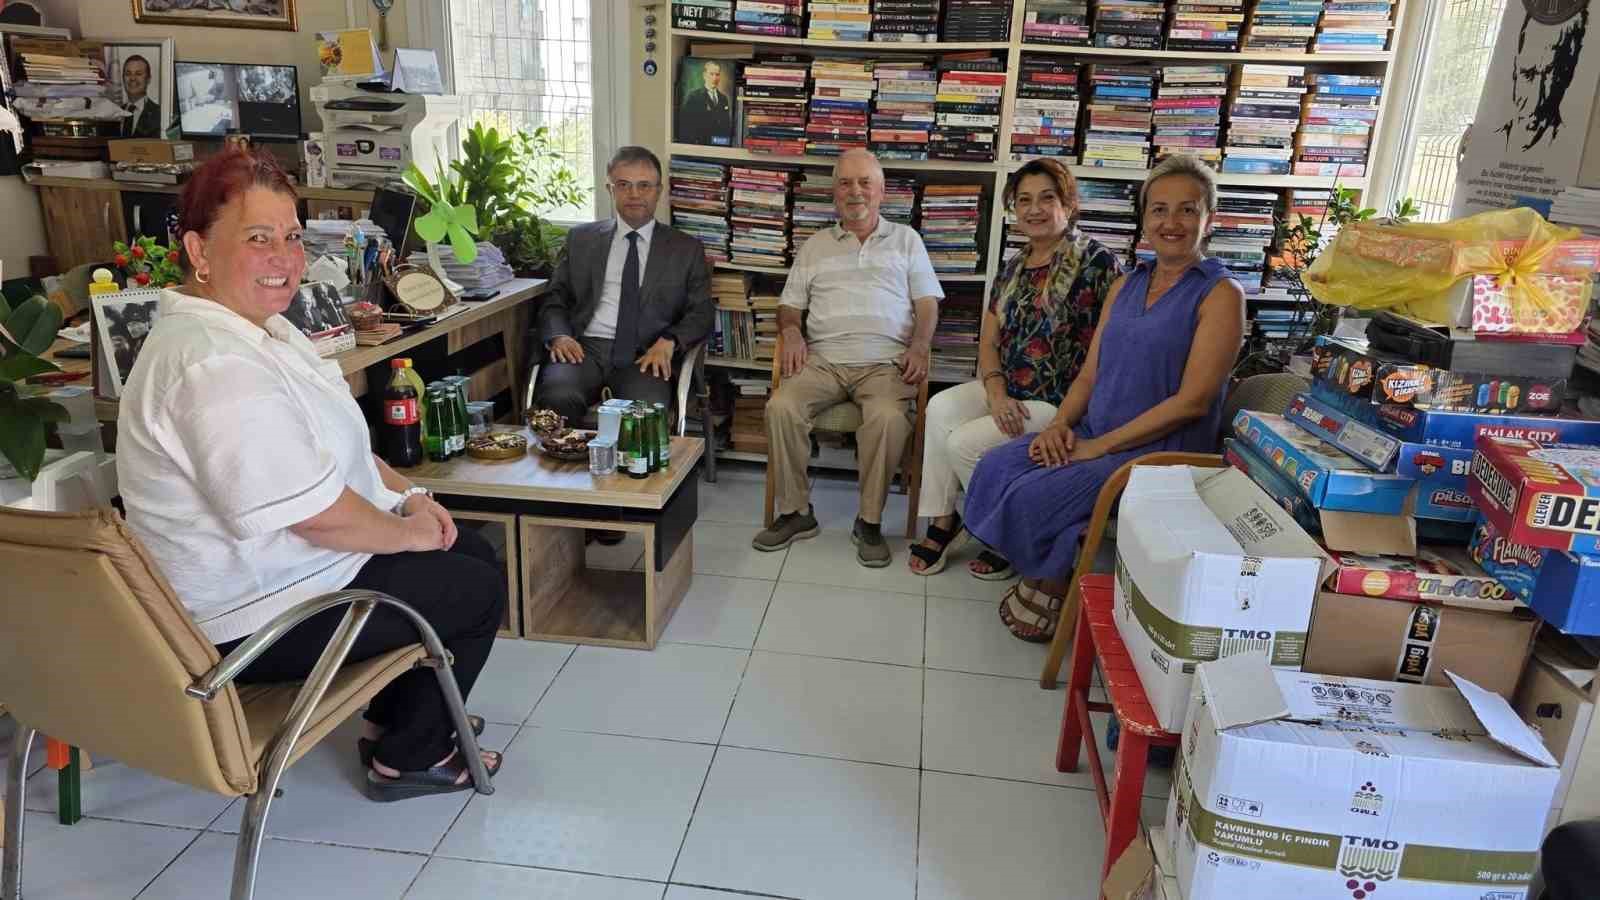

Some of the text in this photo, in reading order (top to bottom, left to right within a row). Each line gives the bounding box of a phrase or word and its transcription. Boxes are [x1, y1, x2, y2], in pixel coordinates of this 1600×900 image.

[1527, 391, 1553, 401] ZOE
[1479, 428, 1557, 442] EMLAK CITY
[1451, 459, 1471, 476] BI
[1434, 490, 1473, 504] pilsa
[1533, 494, 1552, 525] CLEVER
[1549, 495, 1600, 531] DE
[1493, 536, 1542, 568] FLAMINGO
[1224, 628, 1272, 640] TMO
[1214, 829, 1264, 846] VAKUMLU
[1344, 834, 1399, 850] TMO
[1476, 870, 1491, 880] 500
